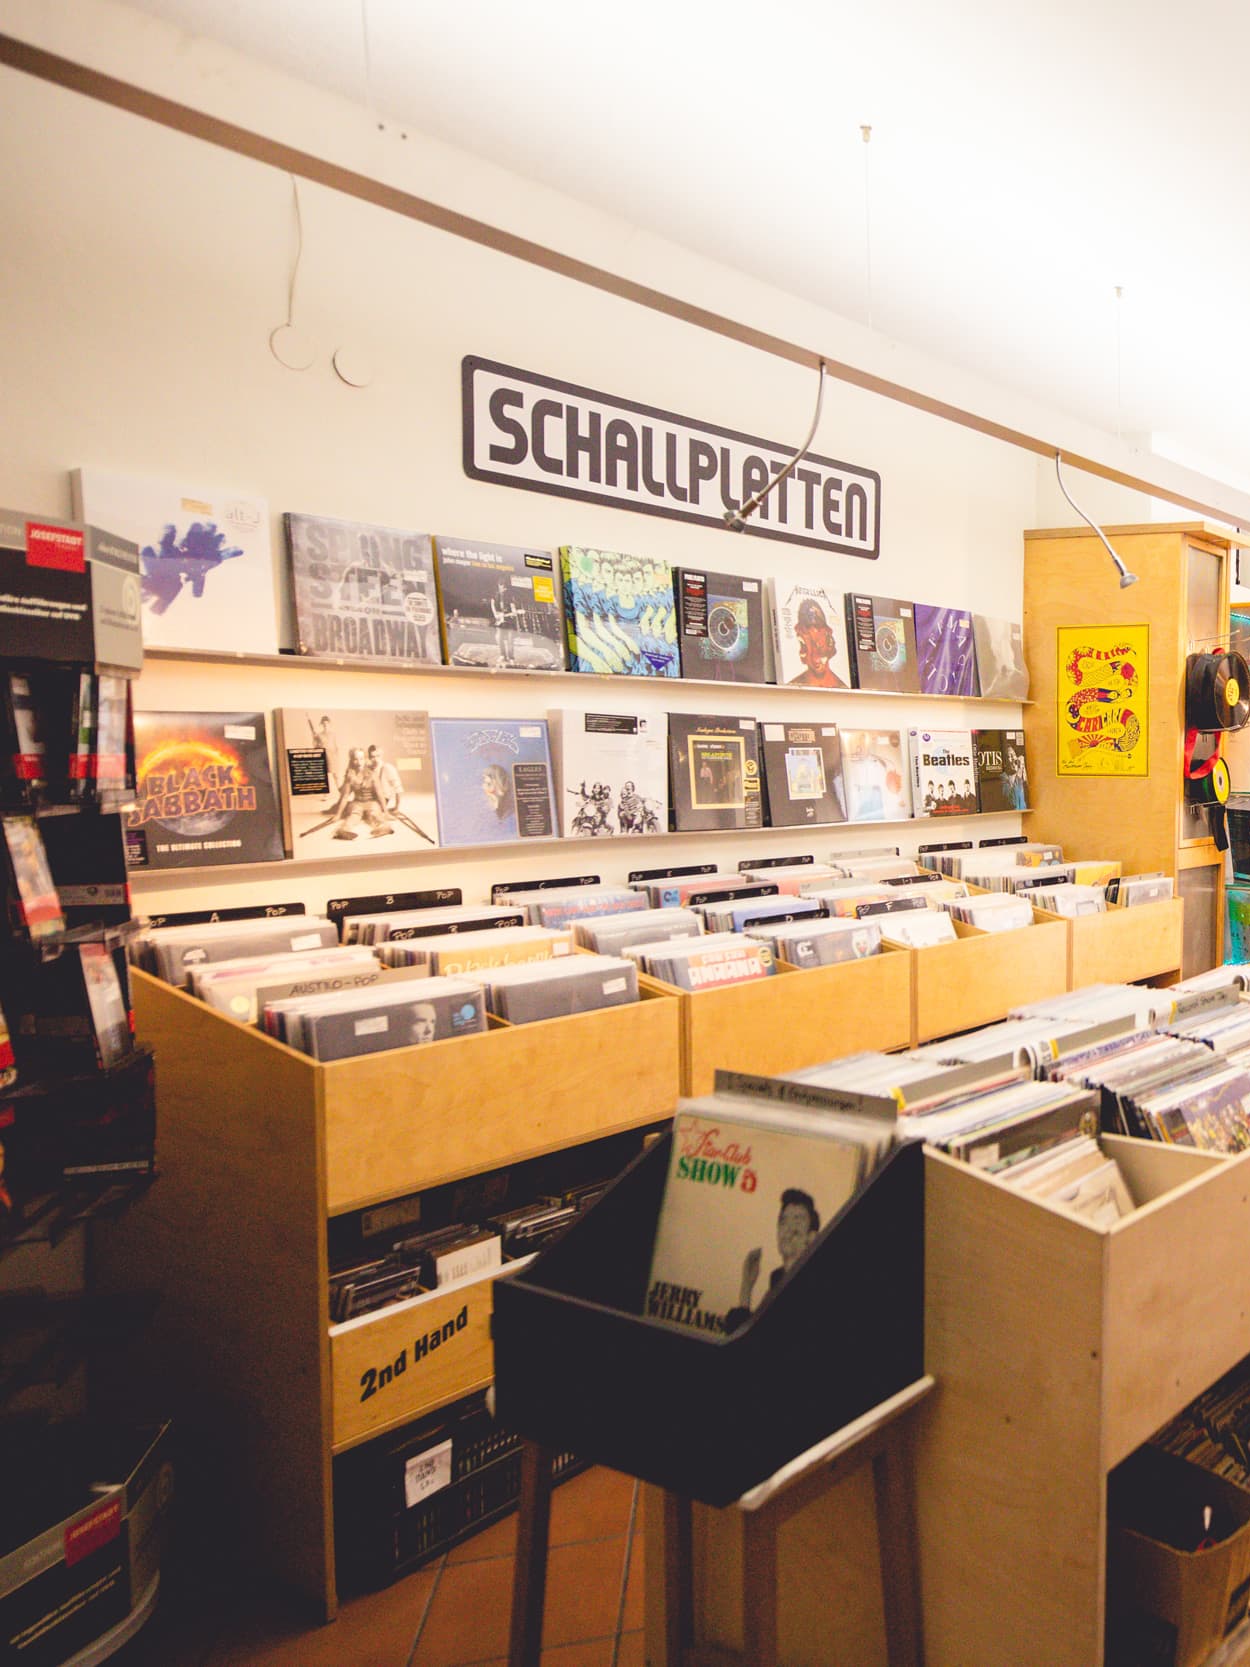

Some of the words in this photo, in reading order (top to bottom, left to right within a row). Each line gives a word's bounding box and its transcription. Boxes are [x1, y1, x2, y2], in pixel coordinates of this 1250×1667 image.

[489, 387, 867, 541] SCHALLPLATTEN
[312, 611, 428, 658] BROADWAY
[147, 764, 236, 796] BLACK
[923, 754, 970, 766] Beatles
[127, 785, 257, 827] SABBATH
[677, 1155, 742, 1189] SHOW
[359, 1349, 407, 1403] 2nd
[414, 1306, 468, 1363] Hand
